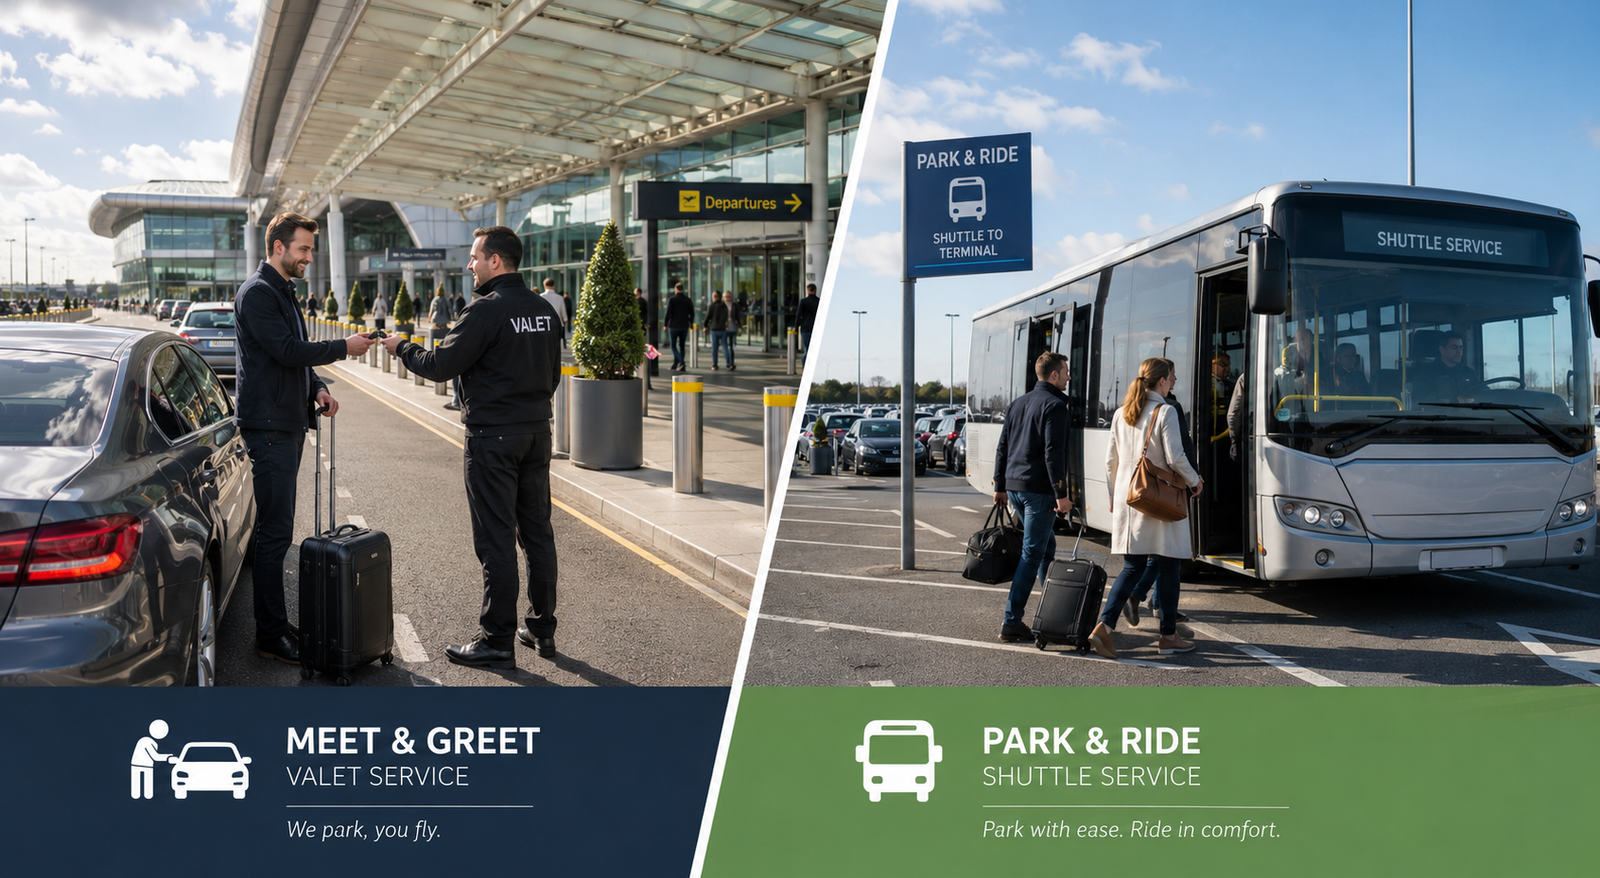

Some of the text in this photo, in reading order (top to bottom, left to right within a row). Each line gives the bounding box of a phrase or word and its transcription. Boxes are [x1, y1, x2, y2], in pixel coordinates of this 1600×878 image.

[917, 146, 1019, 169] PARK & RIDE
[705, 195, 777, 211] Departures
[933, 229, 1004, 245] SHUTTLE TO
[1377, 231, 1503, 256] SHUTTLE SERVICE
[939, 244, 998, 259] TERMINAL
[509, 315, 552, 334] VALET
